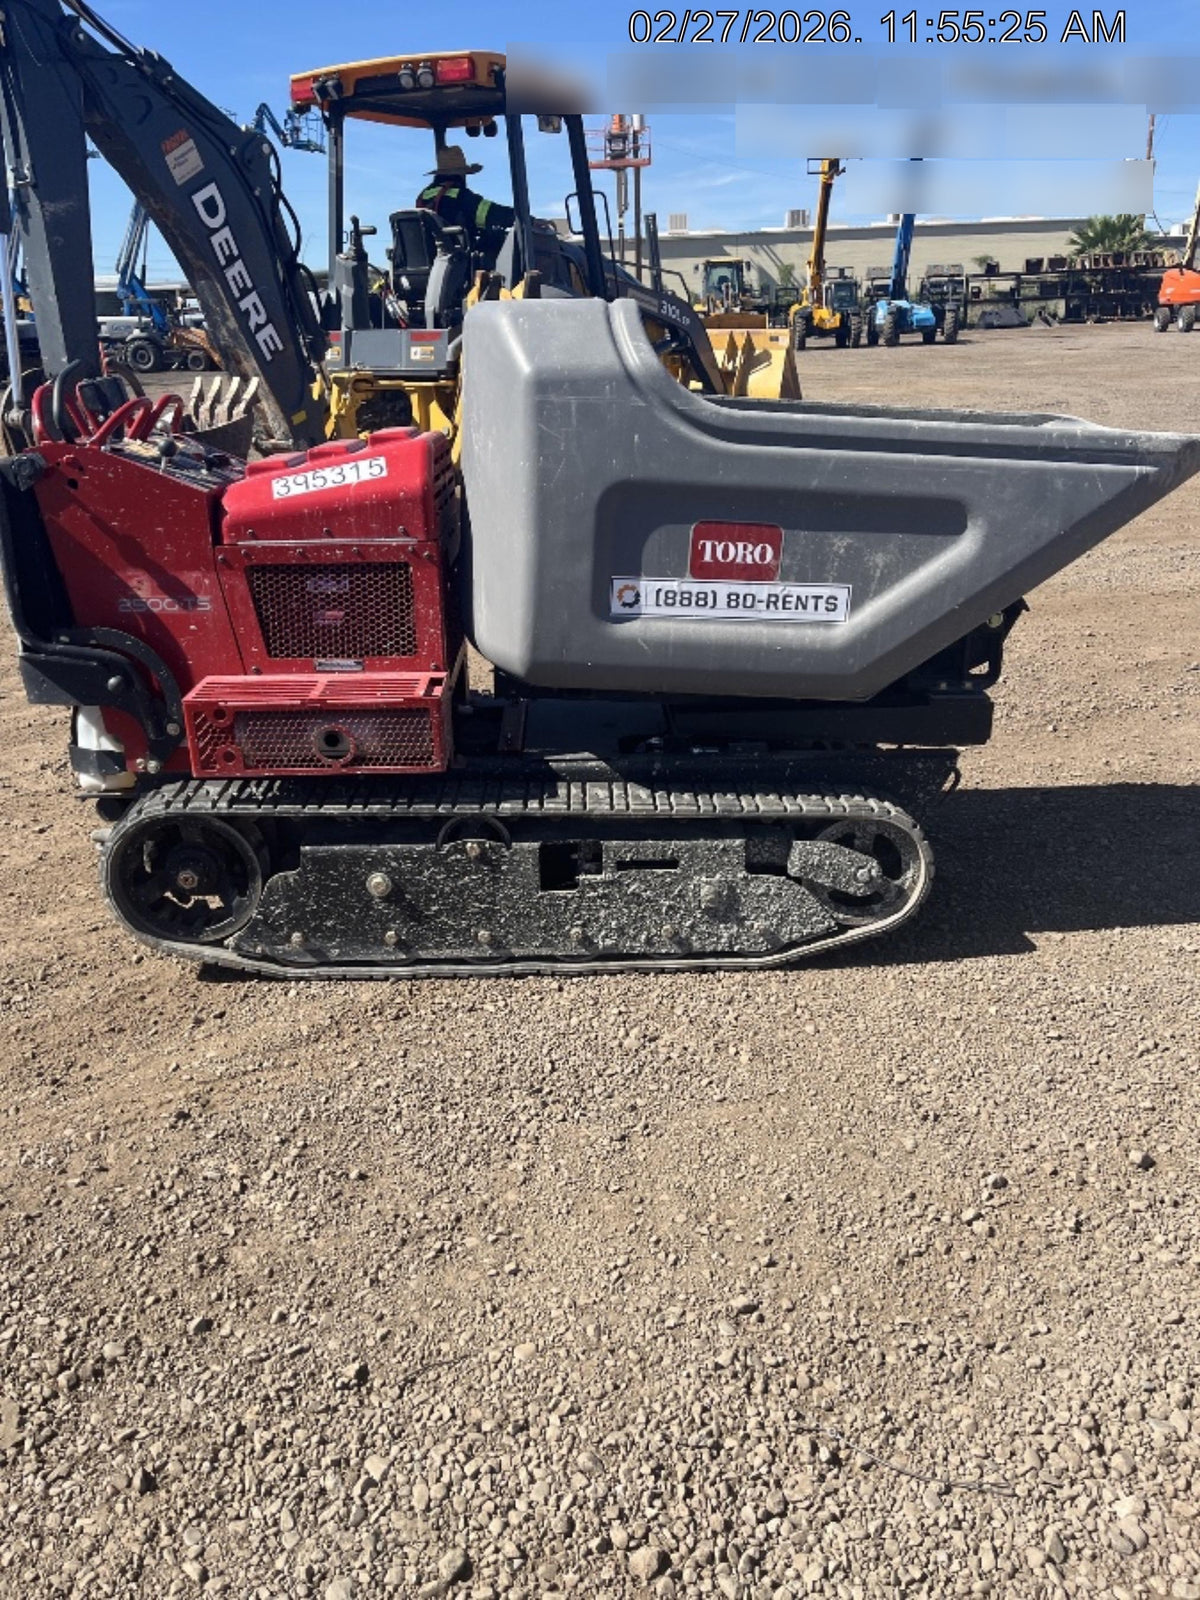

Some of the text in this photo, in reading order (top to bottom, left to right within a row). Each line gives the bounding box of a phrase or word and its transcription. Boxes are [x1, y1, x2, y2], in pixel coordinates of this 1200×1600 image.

[192, 182, 284, 361] DEERE
[276, 458, 384, 496] 395315
[699, 540, 774, 564] TORO
[655, 588, 838, 612] (888) 80-RENTS
